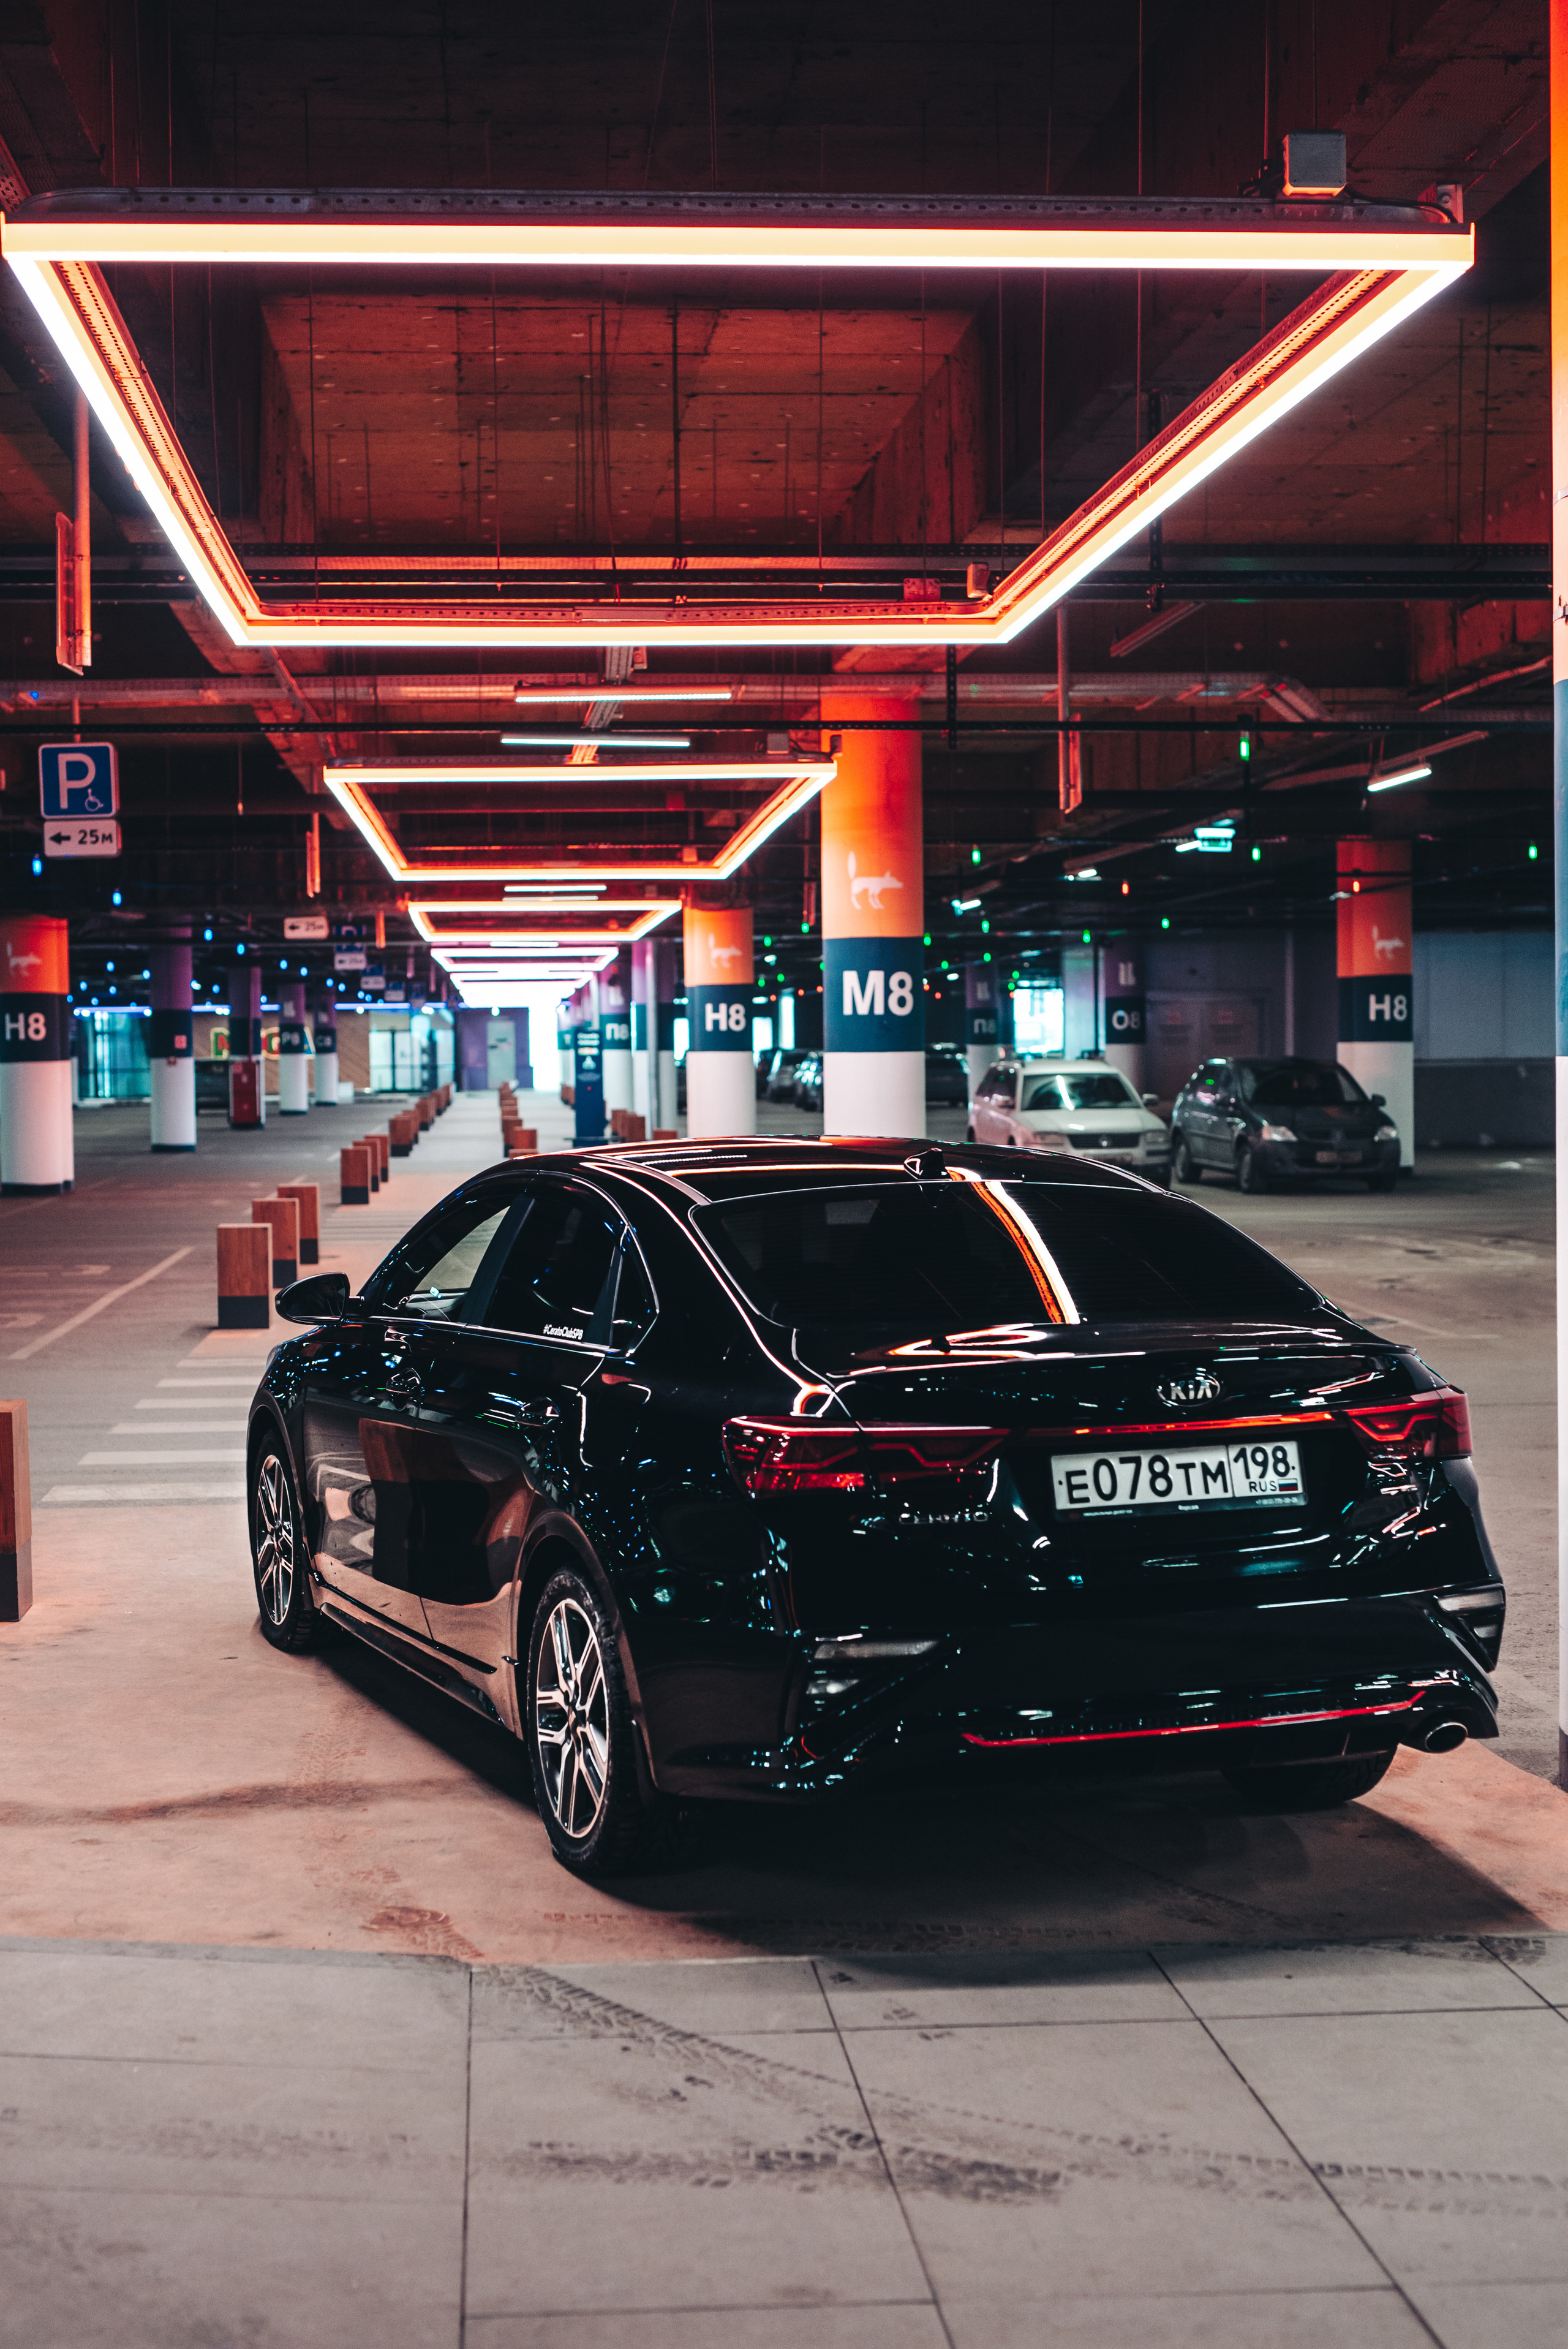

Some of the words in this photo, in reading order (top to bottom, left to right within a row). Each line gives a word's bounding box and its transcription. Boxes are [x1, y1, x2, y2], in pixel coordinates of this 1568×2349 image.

[58, 753, 96, 809] P
[1170, 1376, 1212, 1400] KIA
[1234, 1445, 1291, 1480] 198
[1249, 1480, 1277, 1492] RUS
